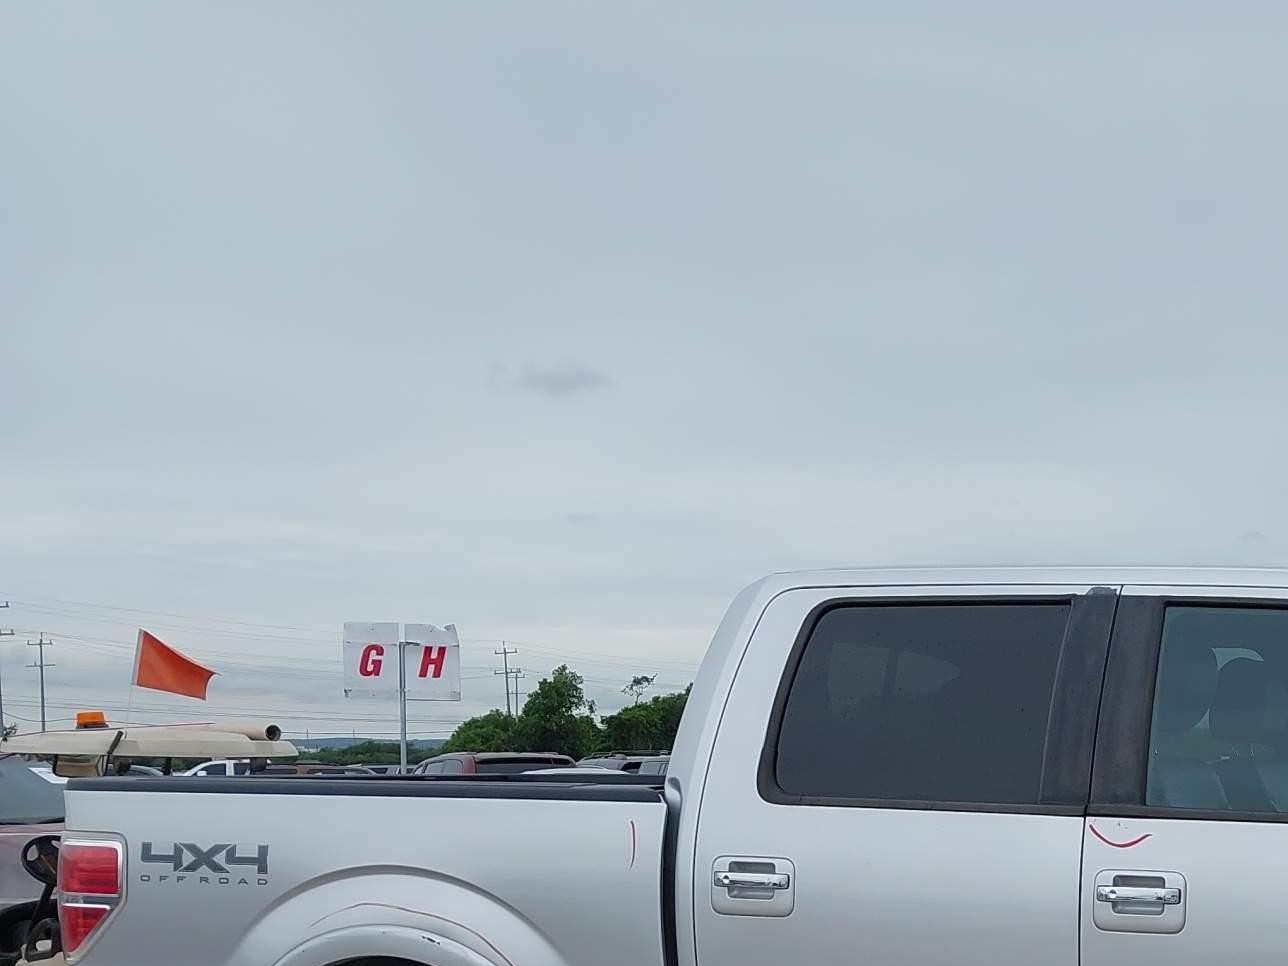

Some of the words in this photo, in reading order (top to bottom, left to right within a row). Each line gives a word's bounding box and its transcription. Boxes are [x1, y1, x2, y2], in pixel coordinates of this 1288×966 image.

[359, 644, 384, 677] G
[419, 646, 447, 679] H
[200, 876, 268, 886] ROAD
